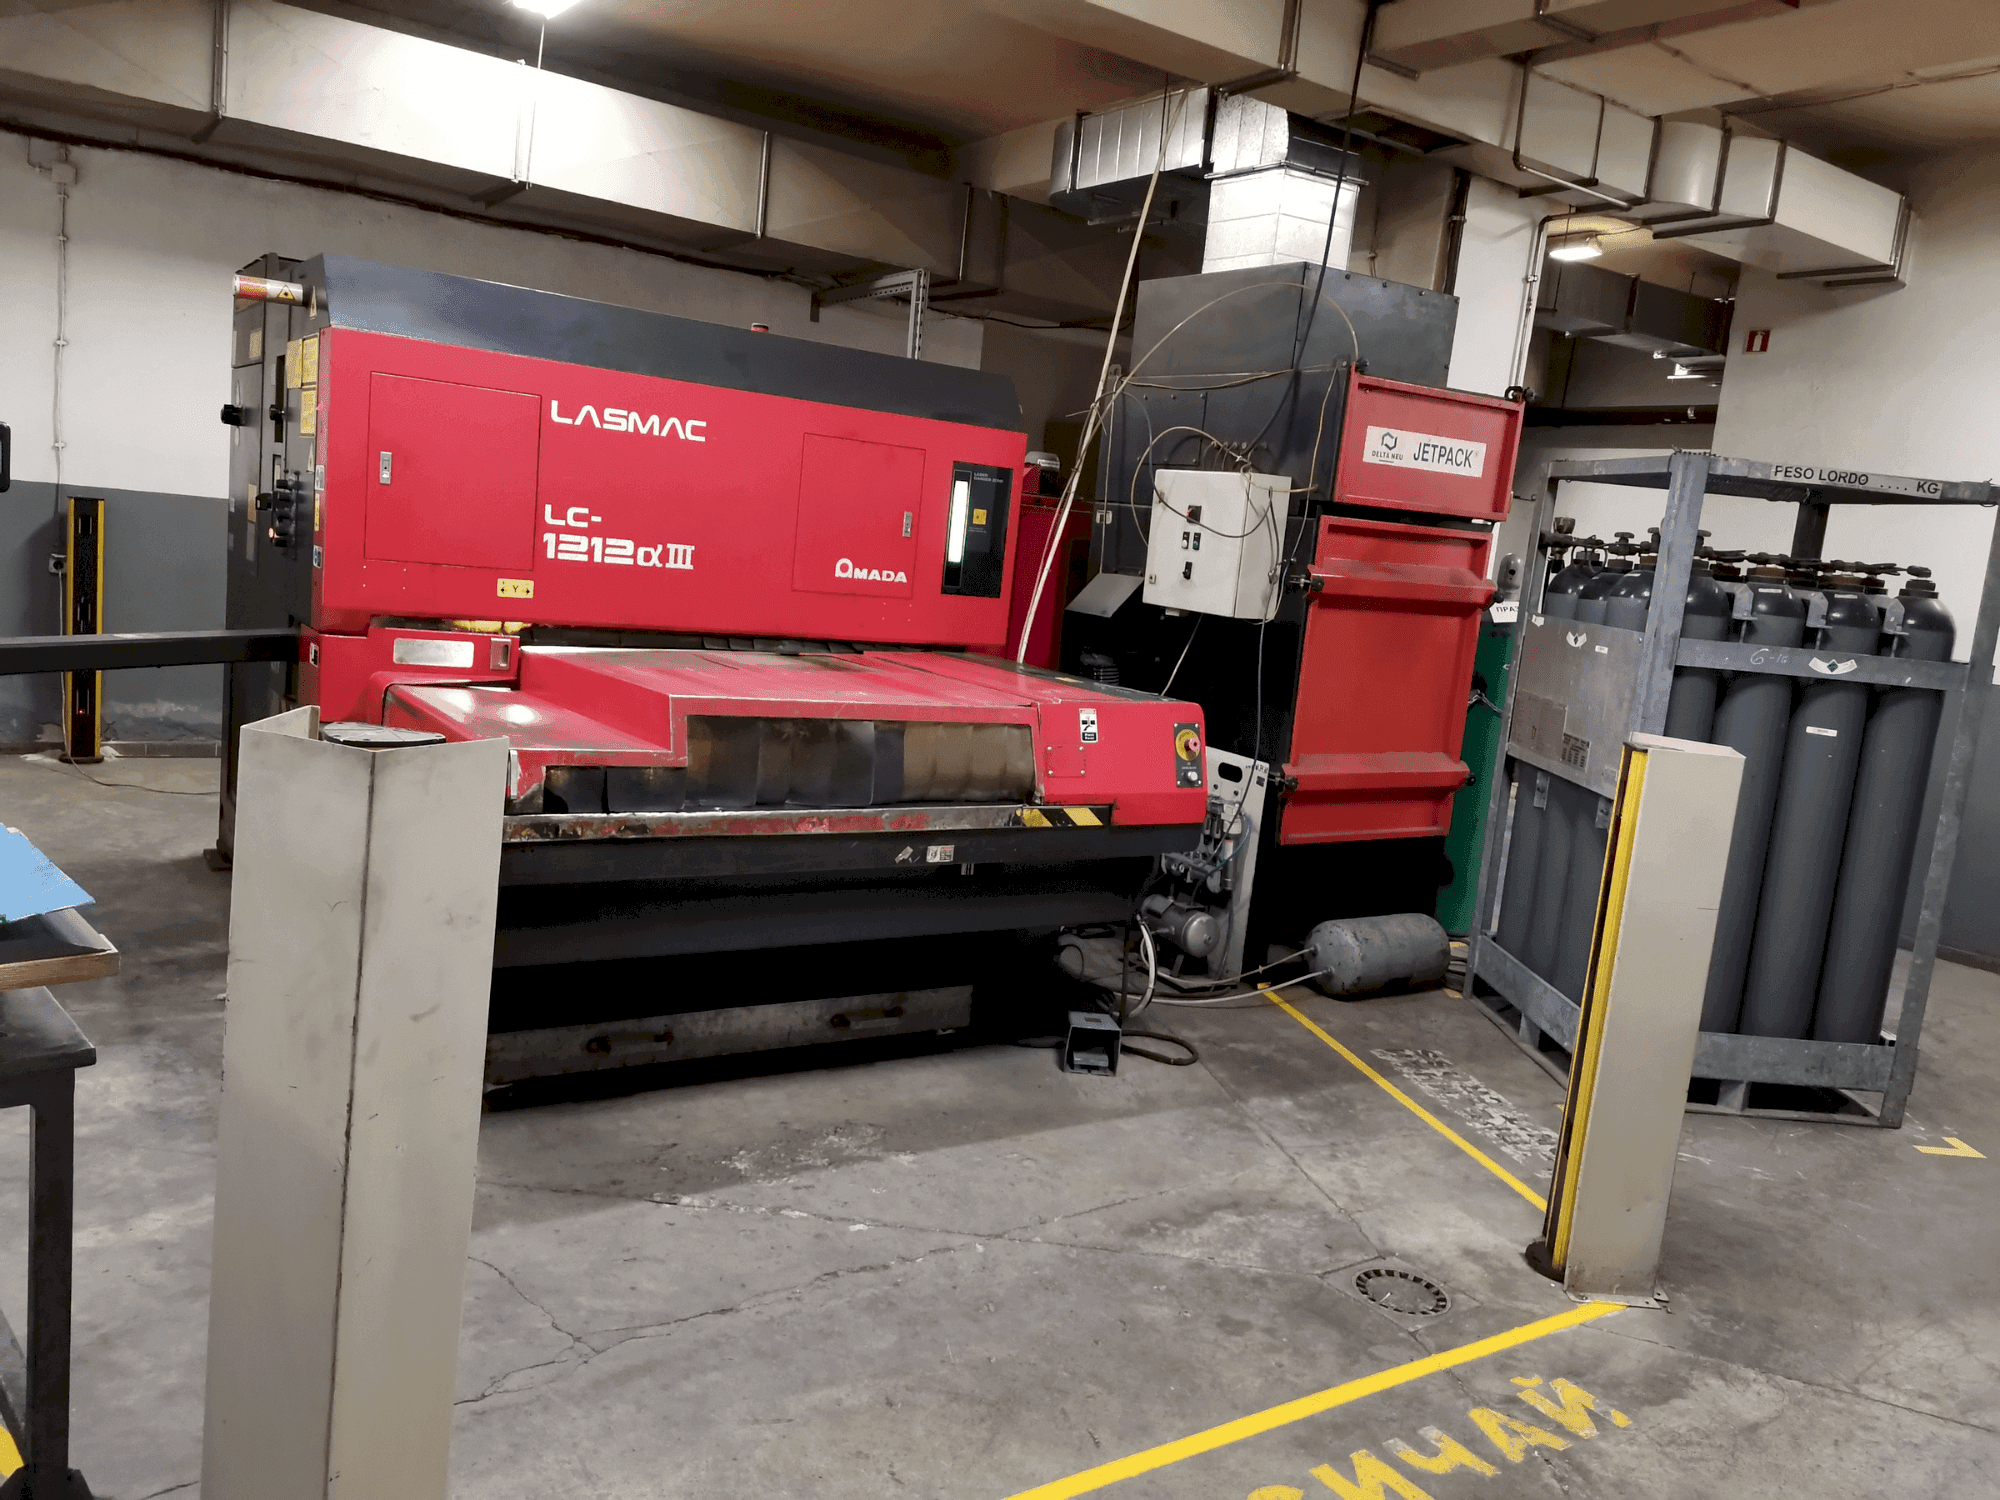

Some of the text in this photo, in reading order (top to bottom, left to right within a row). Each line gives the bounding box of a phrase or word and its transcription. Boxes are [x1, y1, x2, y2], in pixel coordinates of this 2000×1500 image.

[551, 400, 707, 442] LASMAC
[1371, 450, 1403, 461] DELTA NEU
[1413, 442, 1474, 468] JETPACK
[1774, 465, 1815, 480] PESO
[1818, 469, 1869, 486] LORDO
[1916, 481, 1940, 495] KG
[544, 504, 602, 528] LC-
